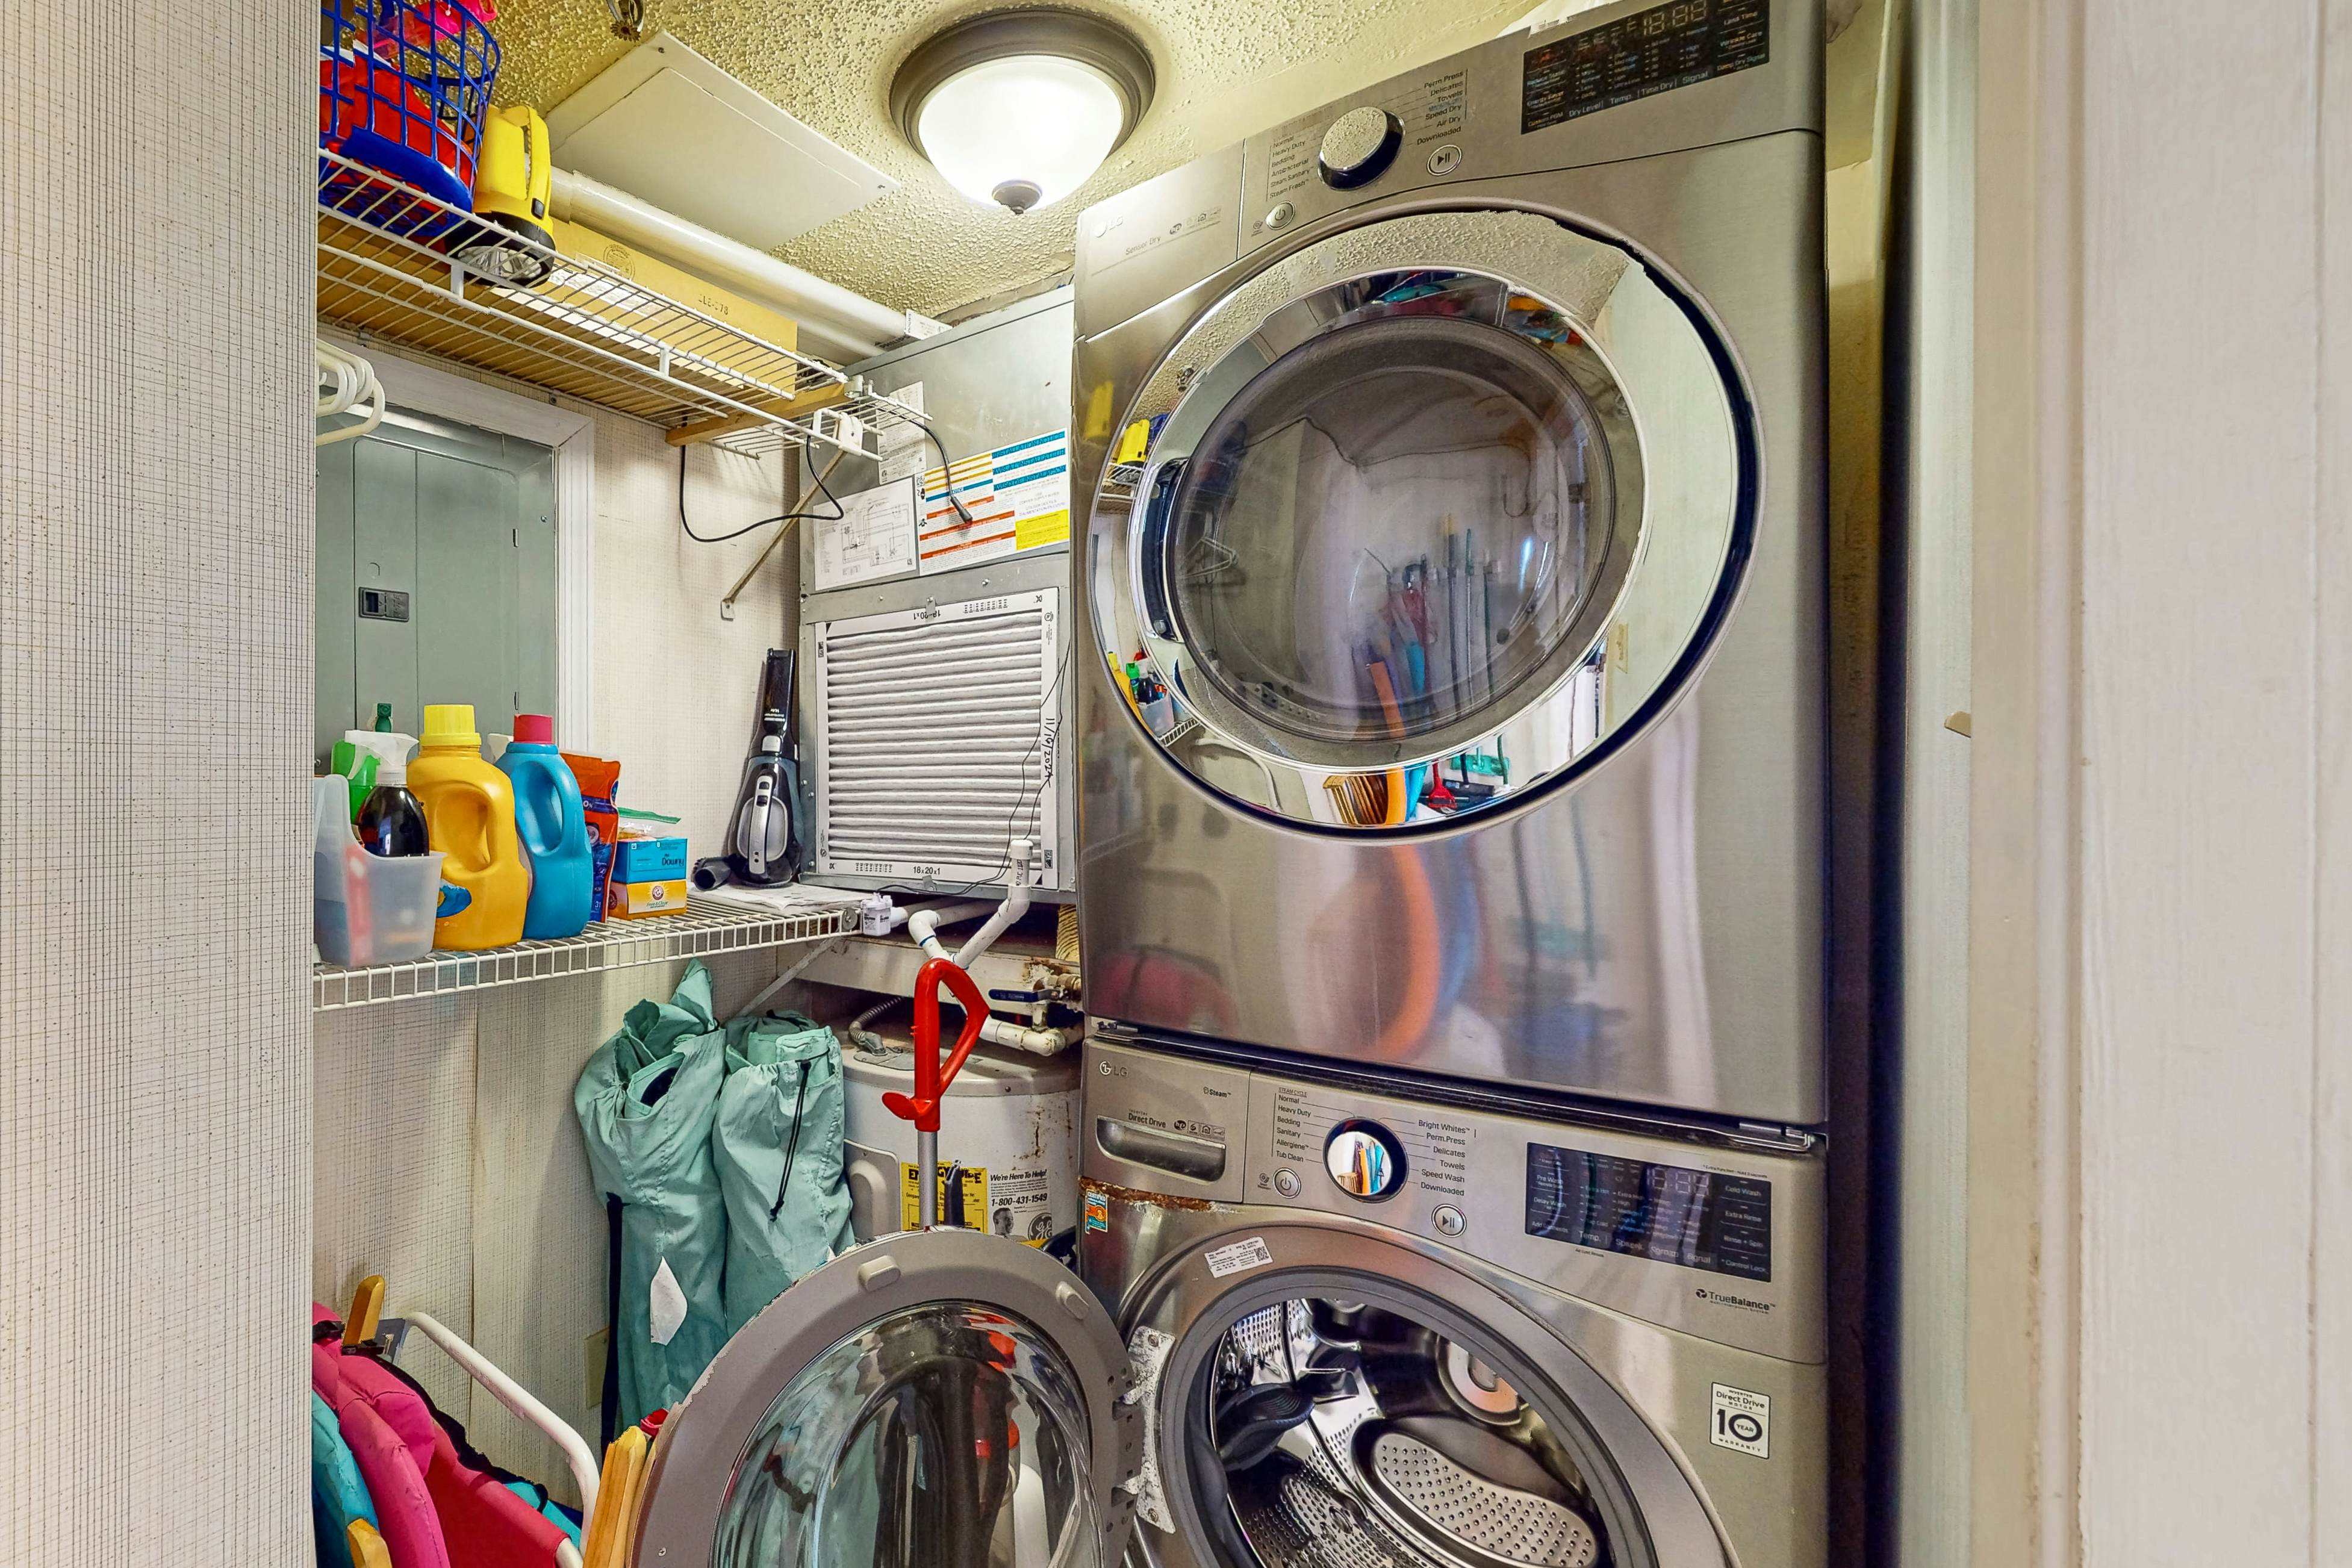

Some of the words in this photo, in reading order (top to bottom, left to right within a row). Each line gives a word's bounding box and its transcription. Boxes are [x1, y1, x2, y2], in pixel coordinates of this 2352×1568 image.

[1424, 79, 1442, 89] Perm
[1444, 71, 1464, 82] Press
[1682, 70, 1708, 84] Signal
[1430, 81, 1463, 96] Delicates
[1641, 86, 1659, 95] Time
[1660, 81, 1673, 90] Dry
[1437, 90, 1463, 102] Towels
[1610, 93, 1632, 105] Temp.
[1425, 108, 1448, 120] Speed
[1449, 104, 1462, 113] Dry
[1569, 109, 1581, 117] Dry
[1582, 102, 1601, 114] Level
[1448, 116, 1461, 125] Dry
[1273, 135, 1294, 148] Normal
[1417, 126, 1461, 145] Downloaded
[1272, 146, 1290, 157] Heavy
[1292, 140, 1306, 150] Duty
[1287, 169, 1310, 181] Sanitary
[1269, 187, 1288, 199] Steam
[1289, 180, 1306, 191] Fresh
[1125, 241, 1148, 256] Sensor
[1149, 235, 1162, 246] Dry
[662, 857, 685, 866] Downy
[1113, 1066, 1127, 1077] LG
[1278, 1094, 1299, 1104] Normal
[1278, 1104, 1296, 1115] Heavy
[1297, 1108, 1311, 1118] Duty
[1128, 1113, 1148, 1124] Direct
[1149, 1117, 1166, 1128] Drive
[1277, 1116, 1301, 1127] Bedding
[1418, 1119, 1439, 1130] Bright
[1277, 1127, 1301, 1139] Sanitary
[1276, 1150, 1287, 1159] Tub
[1287, 1153, 1304, 1162] Clean
[1433, 1146, 1466, 1158] Delicates
[1440, 1159, 1465, 1171] Towels
[1031, 1168, 1047, 1178] Help!
[1421, 1168, 1443, 1179] Speed
[1444, 1173, 1465, 1183] Wash
[1420, 1181, 1464, 1196] Downloaded
[1725, 1185, 1741, 1194] Cold
[1742, 1188, 1762, 1197] Wash
[991, 1192, 1048, 1207] 1-800-431-1549
[1725, 1210, 1743, 1219] Extra
[1744, 1213, 1762, 1223] Rinse
[1579, 1231, 1601, 1242] Temp.
[1723, 1235, 1742, 1245] Rinse
[1749, 1239, 1764, 1248] Spin
[1726, 1258, 1750, 1270] Control
[1750, 1263, 1767, 1273] Lock
[1716, 1391, 1741, 1403] Direct
[1743, 1398, 1765, 1409] Drive
[1728, 1401, 1753, 1410] MOTOR
[1717, 1408, 1762, 1443] 10
[1736, 1423, 1755, 1433] YEAR
[1719, 1438, 1761, 1452] WARRANTY
